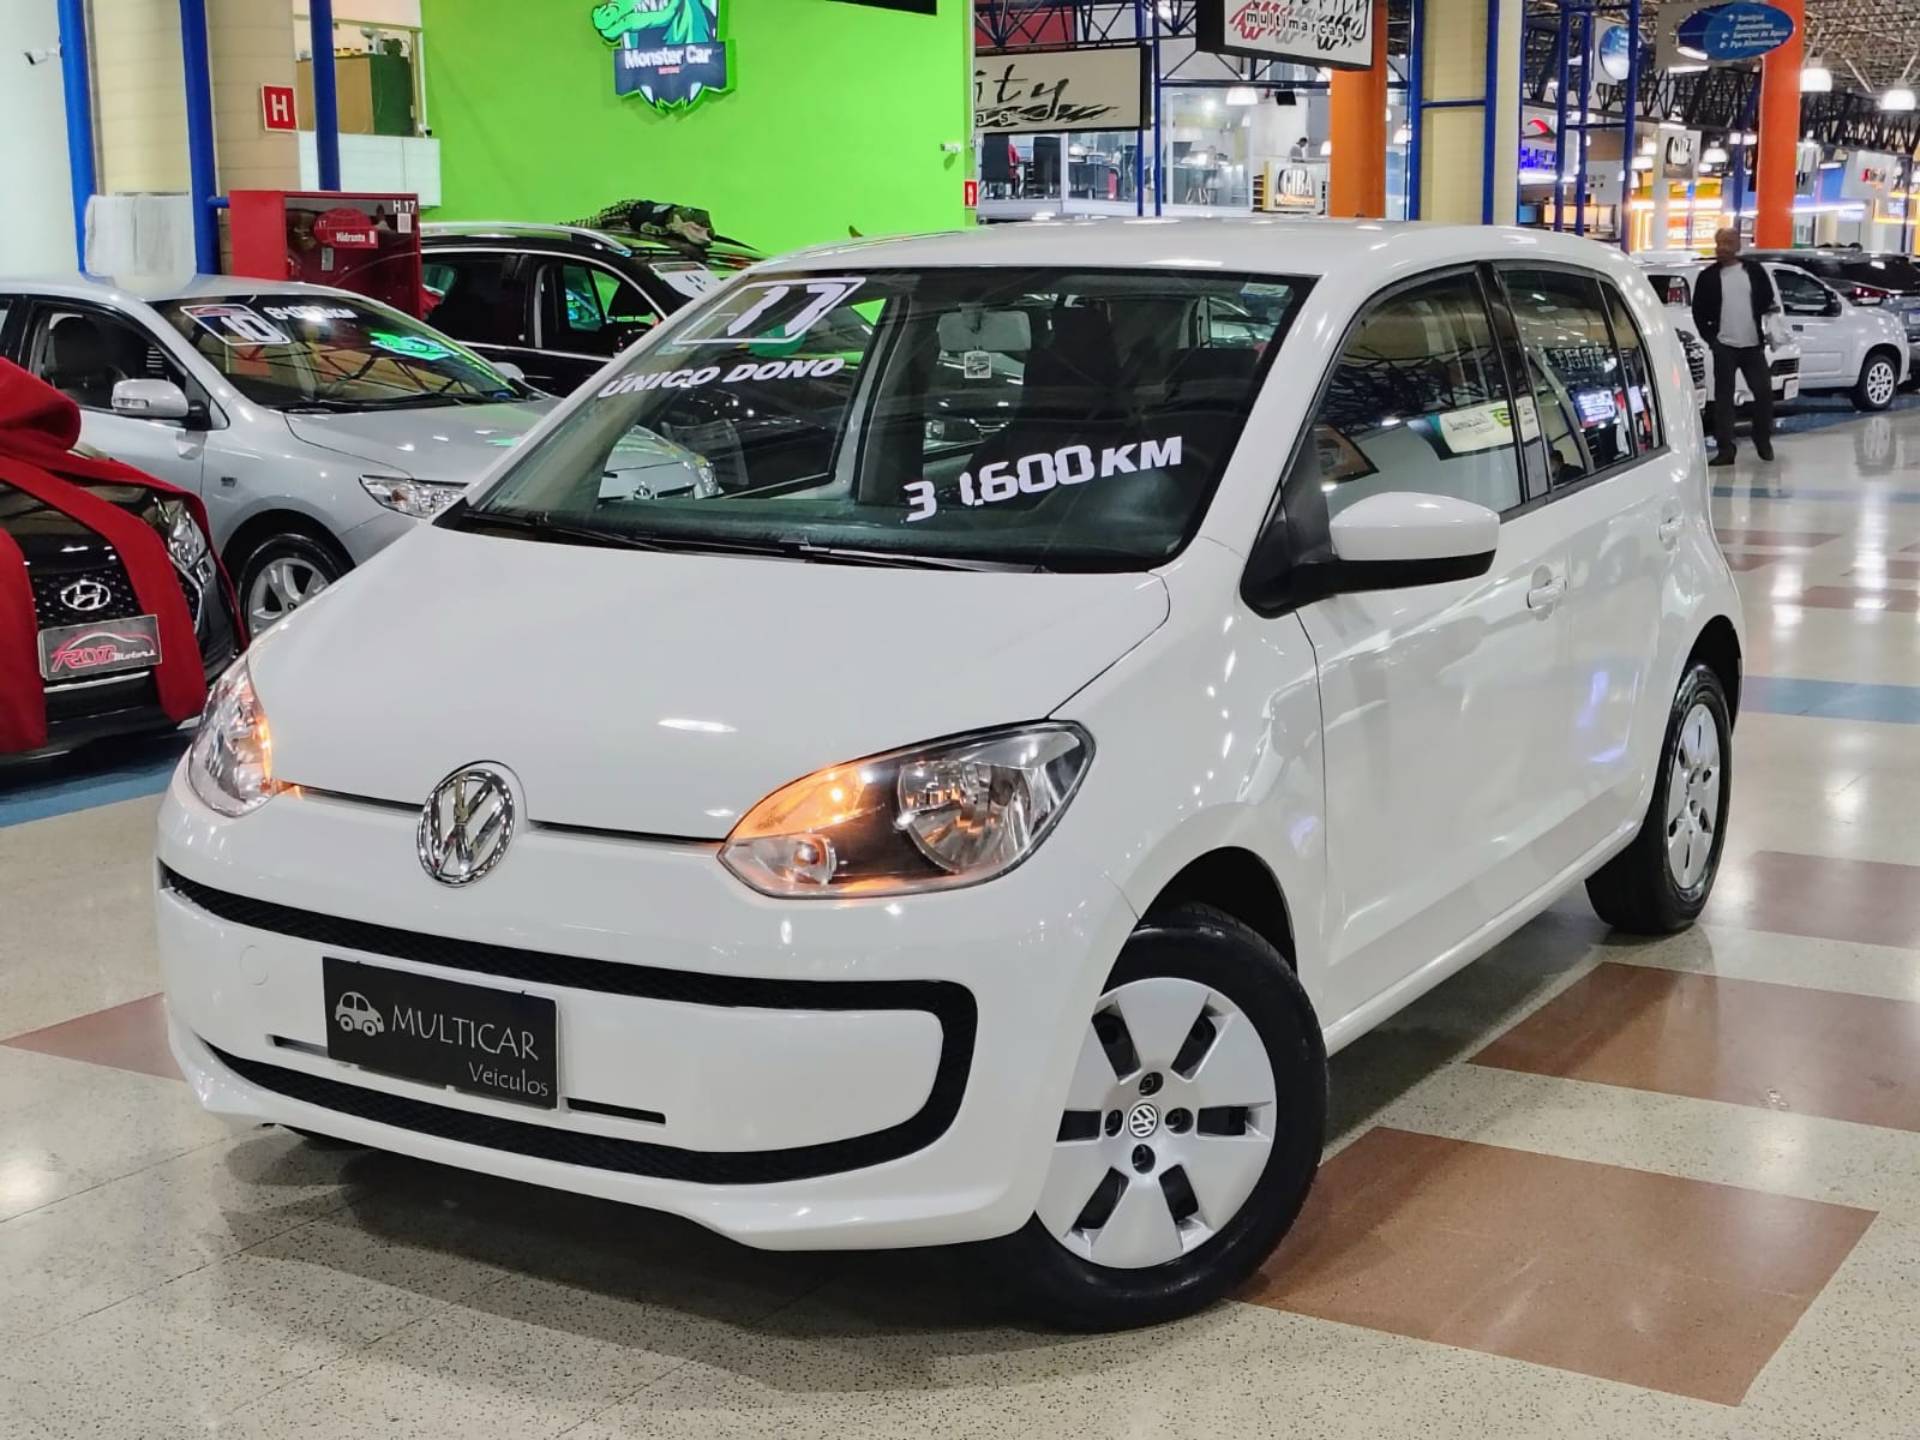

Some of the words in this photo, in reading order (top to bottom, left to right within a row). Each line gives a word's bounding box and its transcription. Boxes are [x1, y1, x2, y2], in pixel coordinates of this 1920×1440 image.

[1246, 11, 1344, 38] multimarcas
[624, 47, 684, 69] Monster
[685, 45, 712, 64] Car
[271, 94, 289, 122] H
[392, 200, 401, 213] H
[403, 200, 417, 213] 17
[597, 365, 721, 399] ÚNICO
[721, 357, 845, 384] DONO
[391, 1004, 539, 1062] MULTICAR
